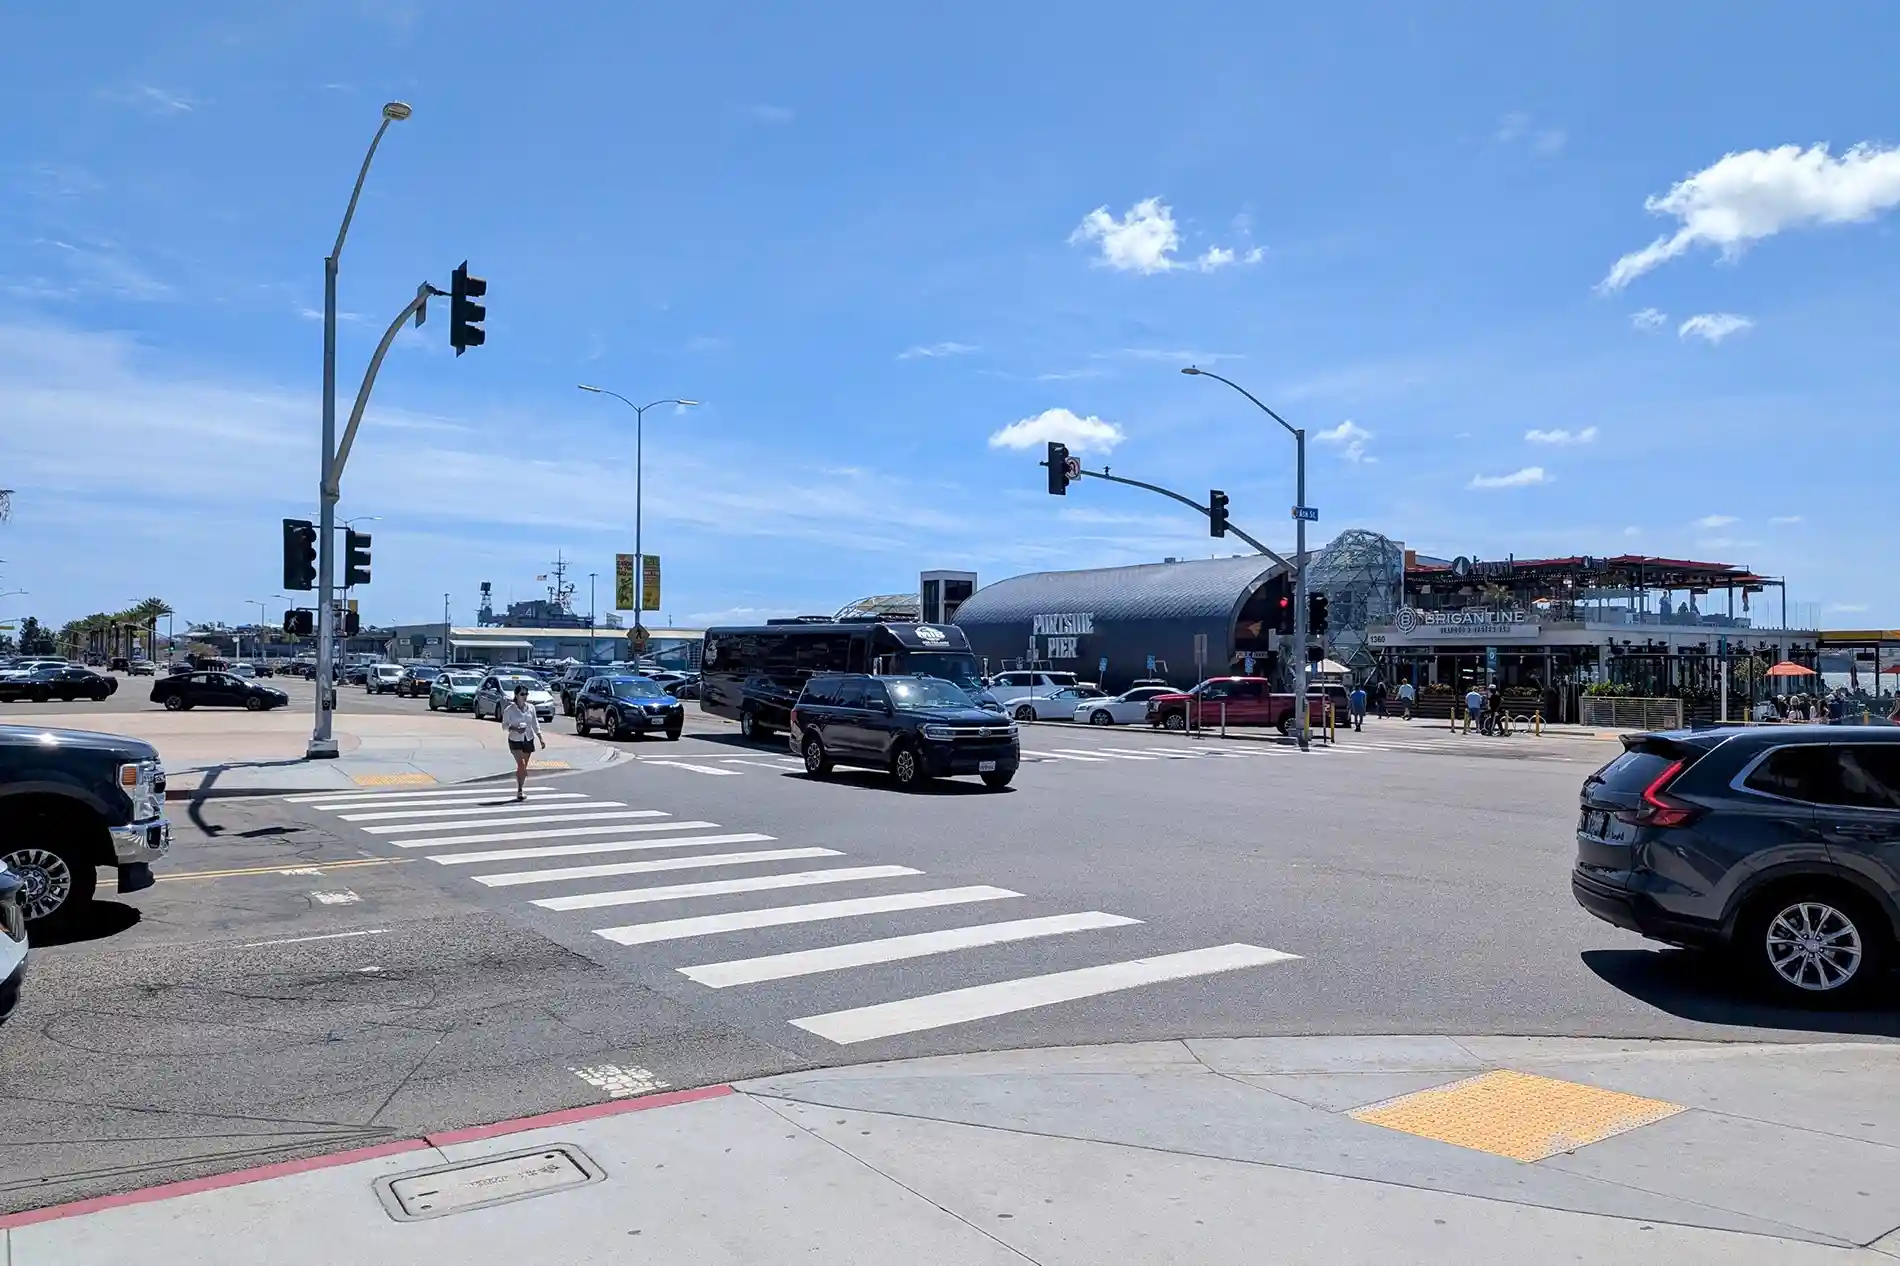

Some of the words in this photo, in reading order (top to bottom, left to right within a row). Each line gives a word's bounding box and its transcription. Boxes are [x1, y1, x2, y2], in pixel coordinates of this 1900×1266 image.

[1425, 611, 1525, 625] BRIGANTINE
[1370, 635, 1386, 644] 1360
[1047, 636, 1079, 659] PIER
